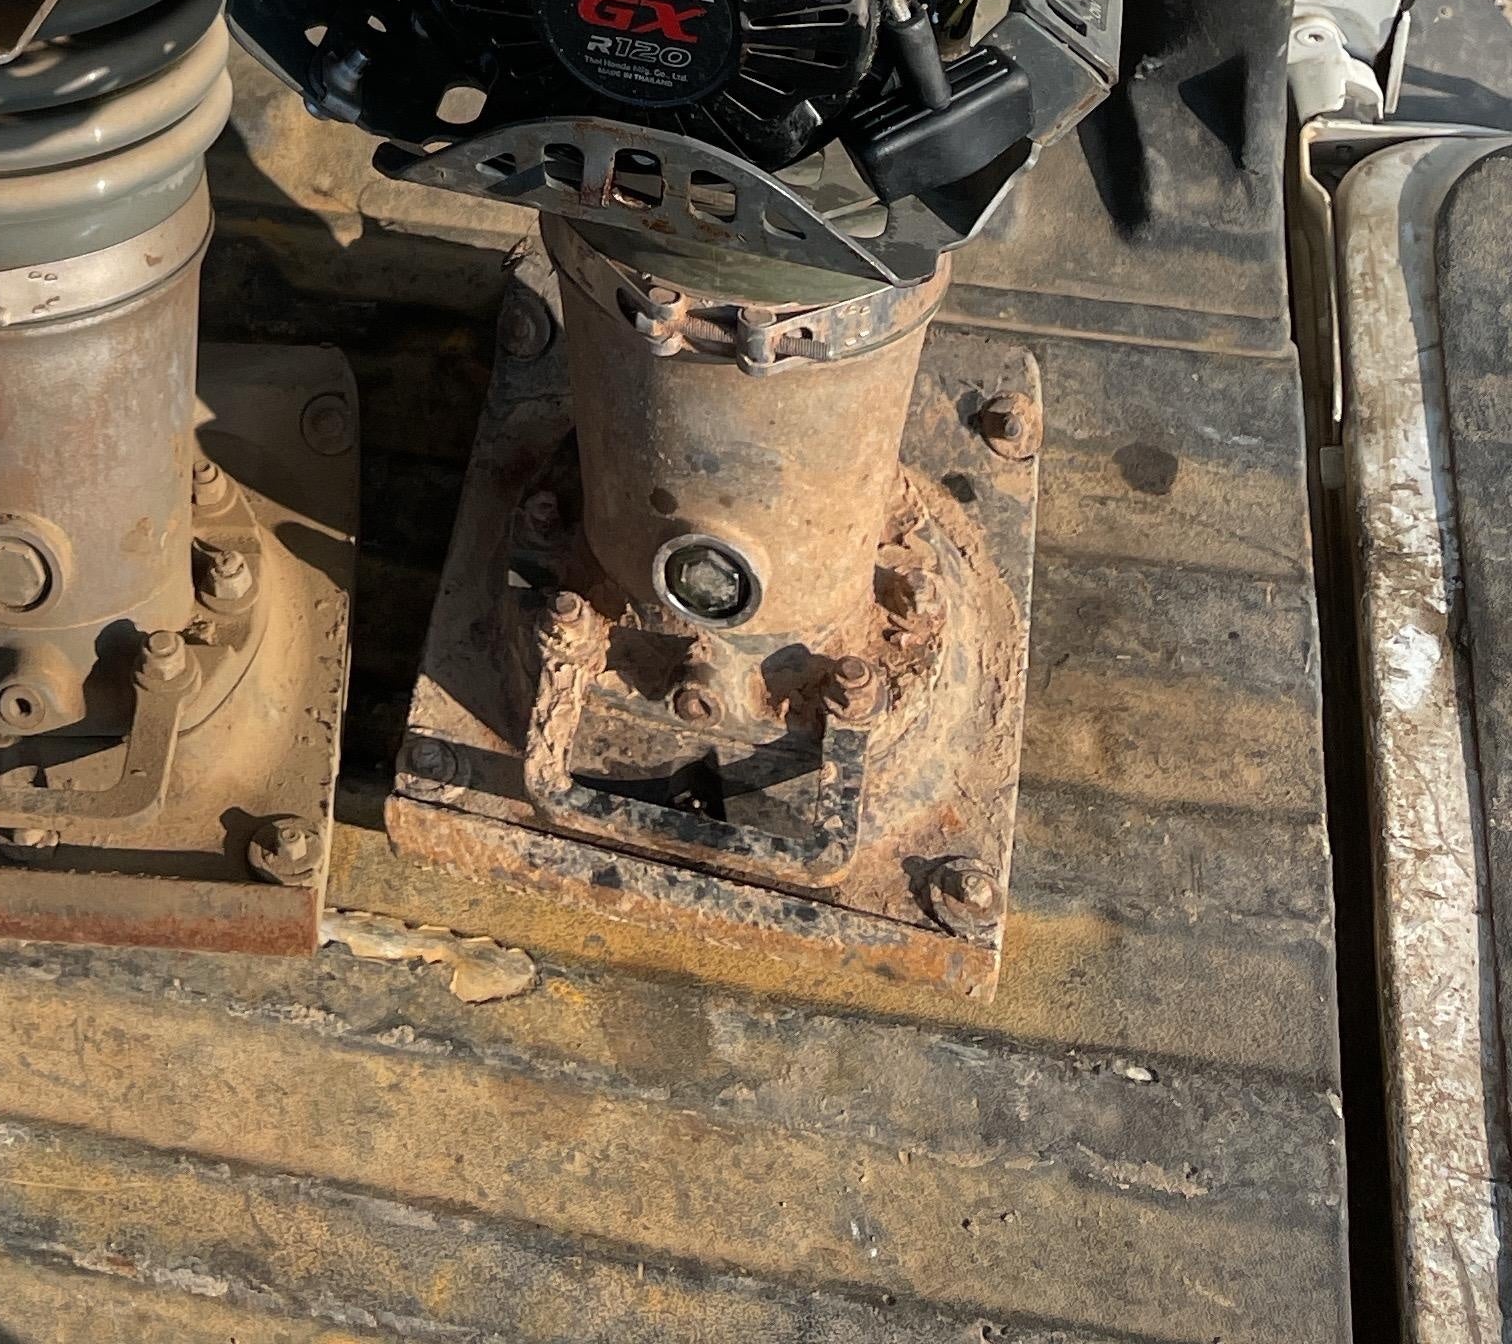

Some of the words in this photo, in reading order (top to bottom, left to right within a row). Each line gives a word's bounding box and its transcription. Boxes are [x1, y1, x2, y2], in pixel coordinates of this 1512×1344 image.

[587, 35, 692, 68] R120
[603, 58, 631, 71] Honda
[634, 73, 673, 87] THAILAND
